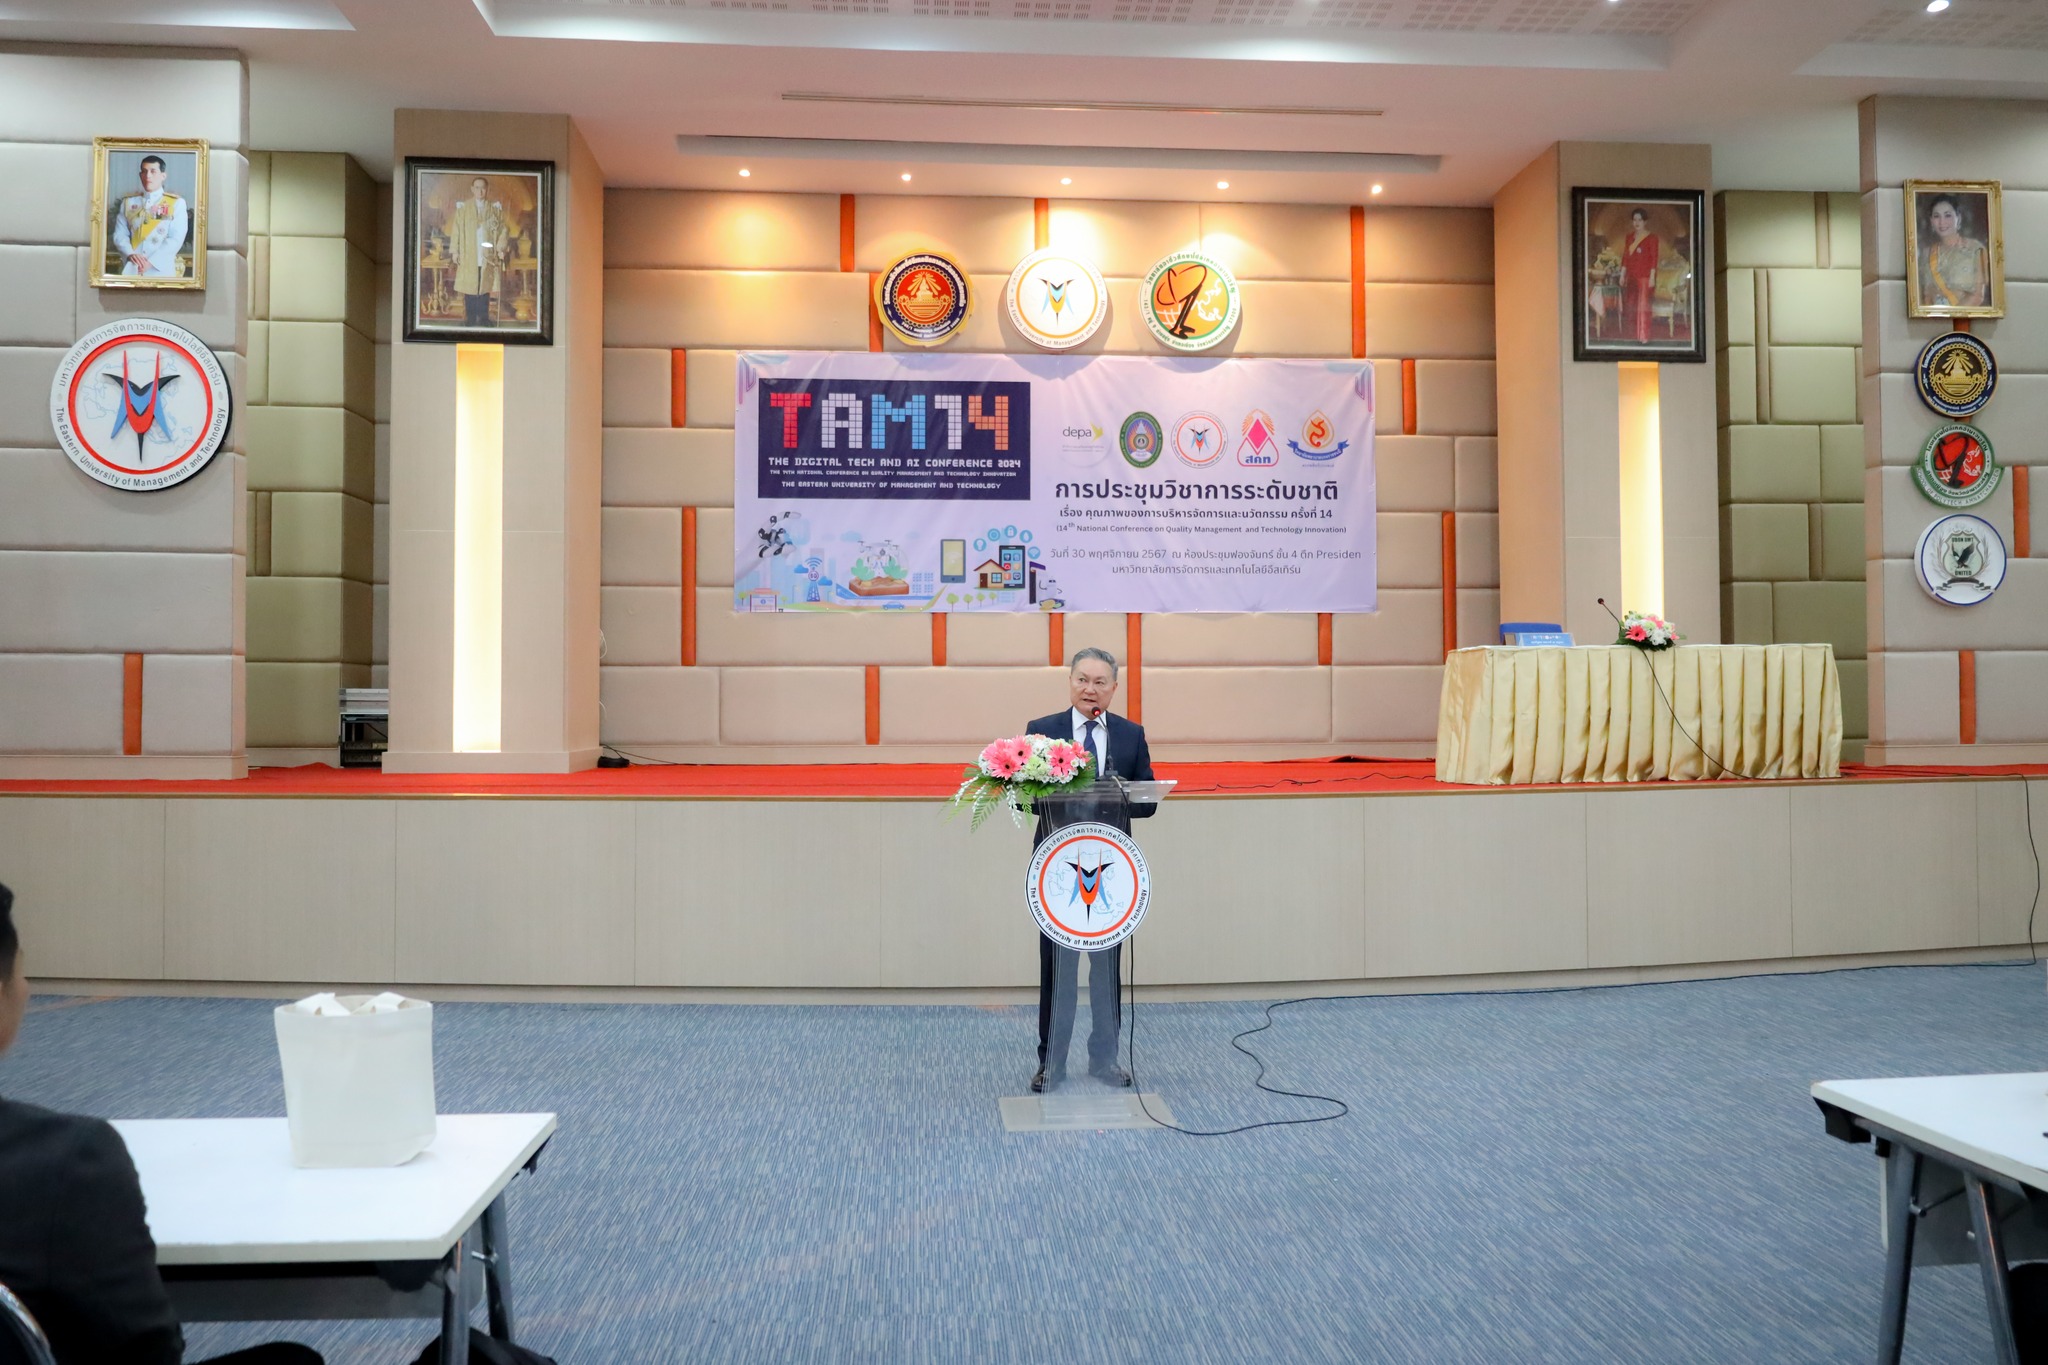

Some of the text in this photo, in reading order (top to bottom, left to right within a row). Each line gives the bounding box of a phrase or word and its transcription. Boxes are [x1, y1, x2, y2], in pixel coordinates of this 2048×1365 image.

[1022, 326, 1044, 344] University
[1053, 334, 1085, 346] Management
[1092, 300, 1105, 327] Technology
[1062, 426, 1092, 439] depa
[56, 407, 226, 487] The Eastern University of Management and Technology
[768, 457, 1021, 468] THE DIGITAL TECH AND AI CONFERENCE 2024
[1055, 479, 1339, 505] การประชุมวิชาการระดับชาติ
[1060, 504, 1332, 520] เรื่อง คุณภาพของการบริหารจัดการและนวัตกรรม ครั้งที่ 14
[1110, 525, 1153, 533] Conference
[1166, 525, 1193, 534] Quality
[1194, 526, 1242, 535] Management
[1261, 526, 1303, 535] Technology
[1304, 526, 1347, 534] Innovation)
[1050, 546, 1069, 558] วันที่
[1072, 550, 1086, 558] 30
[1088, 548, 1139, 561] พฤศจิกายน
[1141, 549, 1167, 558] 2567
[1172, 551, 1181, 559] ณ
[1276, 547, 1289, 559] ชั้น
[1291, 550, 1298, 559] 4
[1300, 548, 1314, 559] ตึก
[1032, 900, 1046, 923] Eastern
[1045, 922, 1072, 944] University
[1082, 931, 1121, 946] Management
[1122, 922, 1132, 933] and
[1130, 889, 1148, 923] Technology
